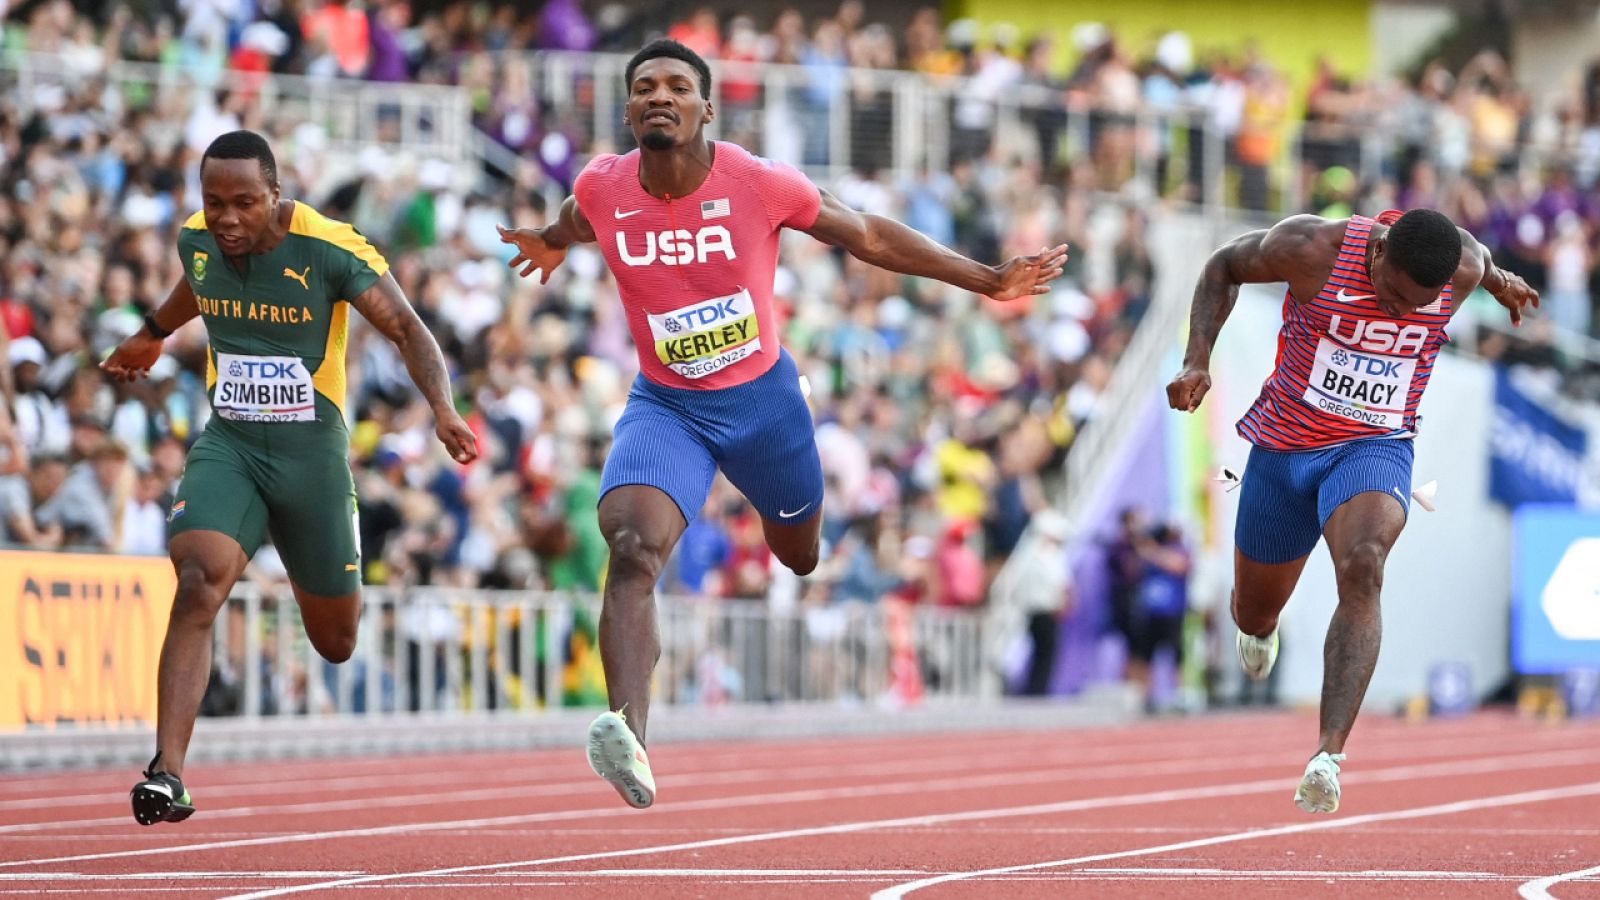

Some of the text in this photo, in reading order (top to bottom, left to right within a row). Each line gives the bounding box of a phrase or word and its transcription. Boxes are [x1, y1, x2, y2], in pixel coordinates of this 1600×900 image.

[615, 225, 737, 267] USA
[248, 301, 314, 325] AFRICA
[677, 297, 740, 330] TDK
[664, 318, 749, 362] KERLEY
[1328, 314, 1430, 355] USA
[242, 361, 298, 380] TDK
[680, 348, 747, 377] OREGON22
[1349, 353, 1403, 379] TDK
[220, 381, 308, 405] SIMBINE
[1322, 368, 1398, 406] BRACY
[1318, 398, 1388, 426] OREGON22
[19, 577, 153, 725] SEIKO
